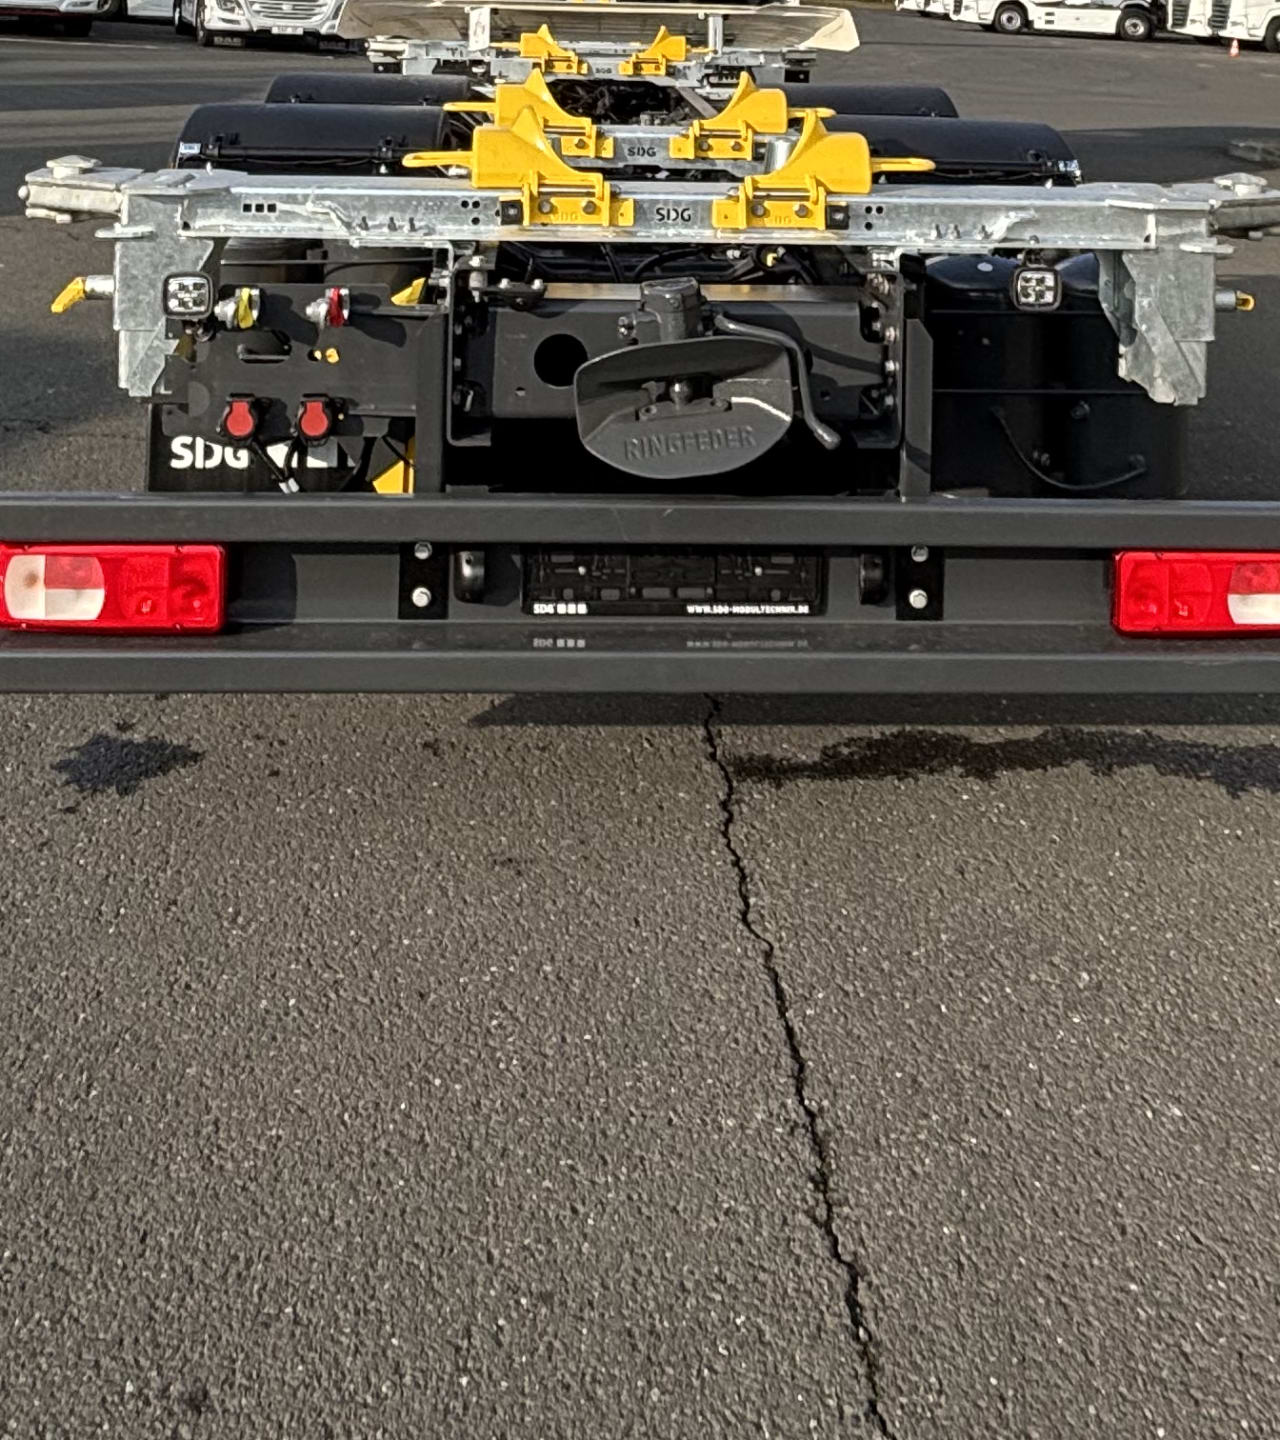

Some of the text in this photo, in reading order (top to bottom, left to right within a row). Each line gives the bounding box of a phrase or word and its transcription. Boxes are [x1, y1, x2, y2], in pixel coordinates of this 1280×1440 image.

[627, 145, 656, 157] SDG
[656, 207, 692, 222] SDG
[170, 436, 249, 469] SDG
[624, 426, 756, 460] RINGFEDER
